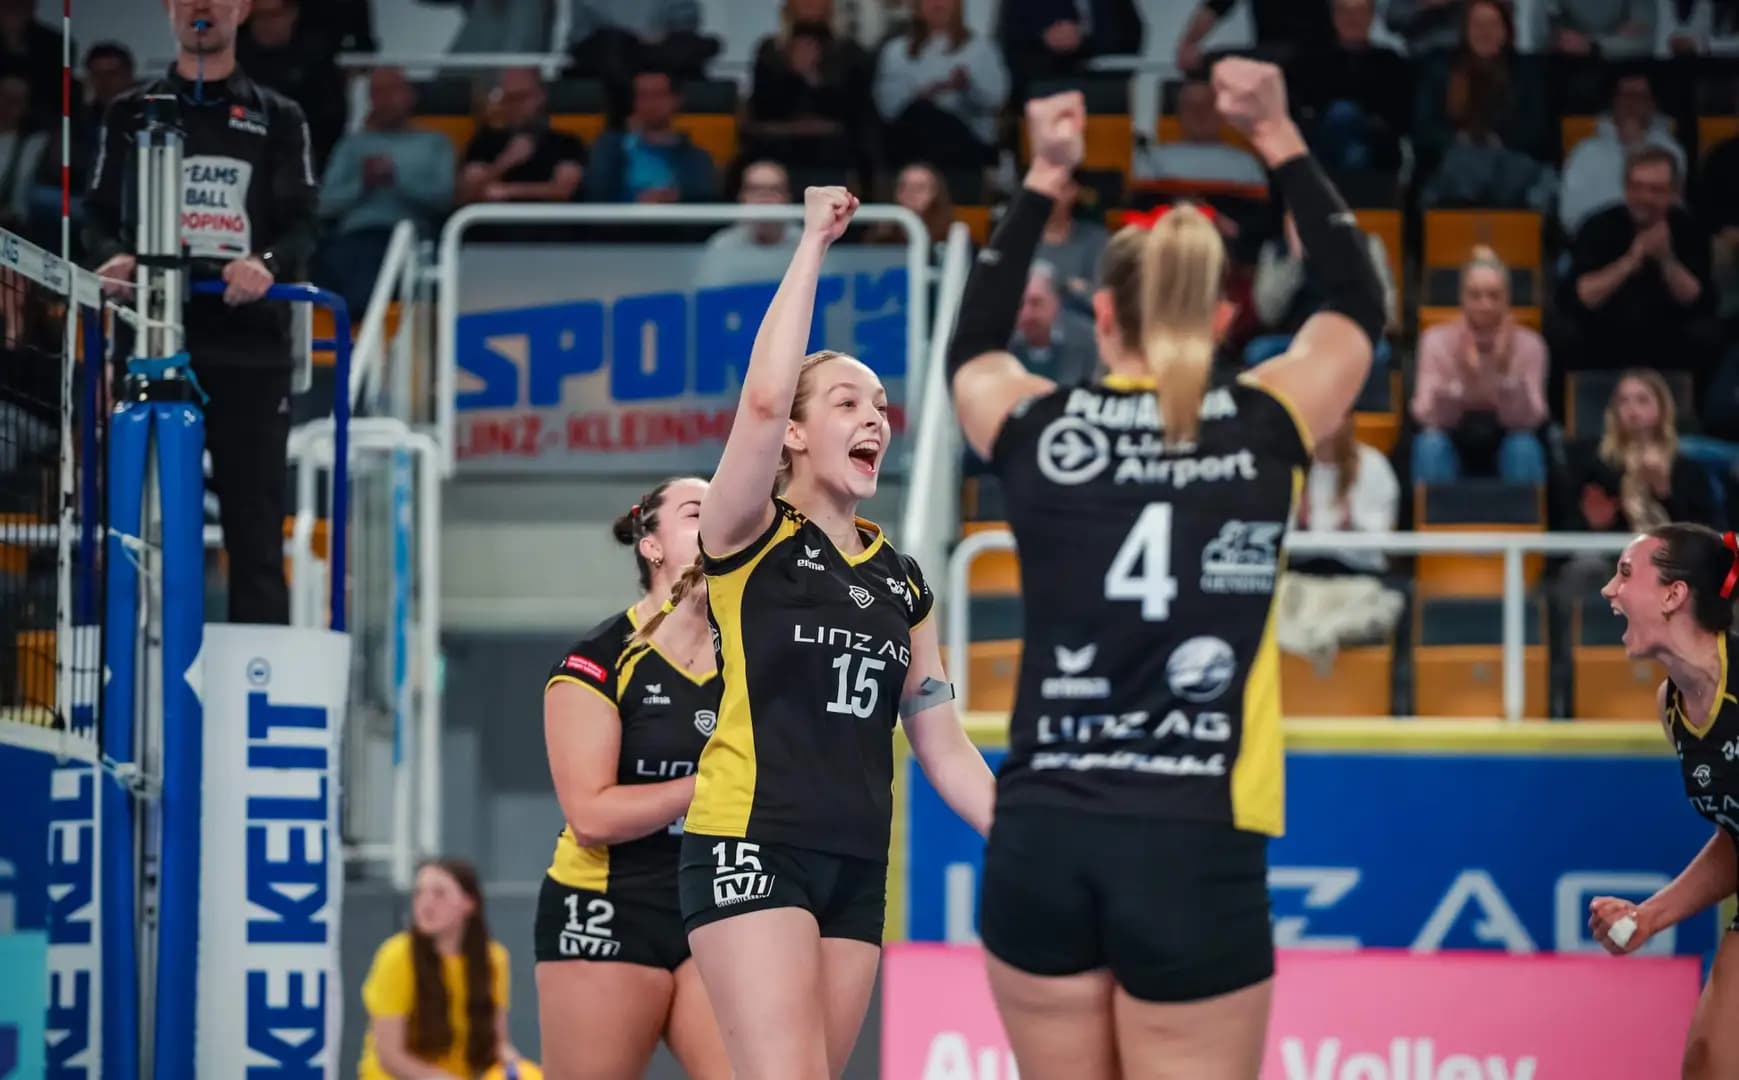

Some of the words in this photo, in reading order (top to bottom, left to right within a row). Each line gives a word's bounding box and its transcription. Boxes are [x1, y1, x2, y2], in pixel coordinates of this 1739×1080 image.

[184, 164, 240, 186] EAMS
[1114, 448, 1259, 490] Airport
[1104, 501, 1178, 622] 4
[794, 624, 873, 652] LINZ
[878, 639, 912, 668] AG
[826, 653, 887, 719] 15
[1037, 710, 1149, 743] LINZ
[1153, 708, 1232, 742] AG
[636, 759, 694, 776] LIN
[246, 691, 329, 944] KELIT
[712, 841, 763, 875] 15
[714, 873, 772, 901] TV1
[563, 894, 615, 936] 12
[246, 970, 327, 1080] KE
[1280, 1037, 1538, 1080] Volley
